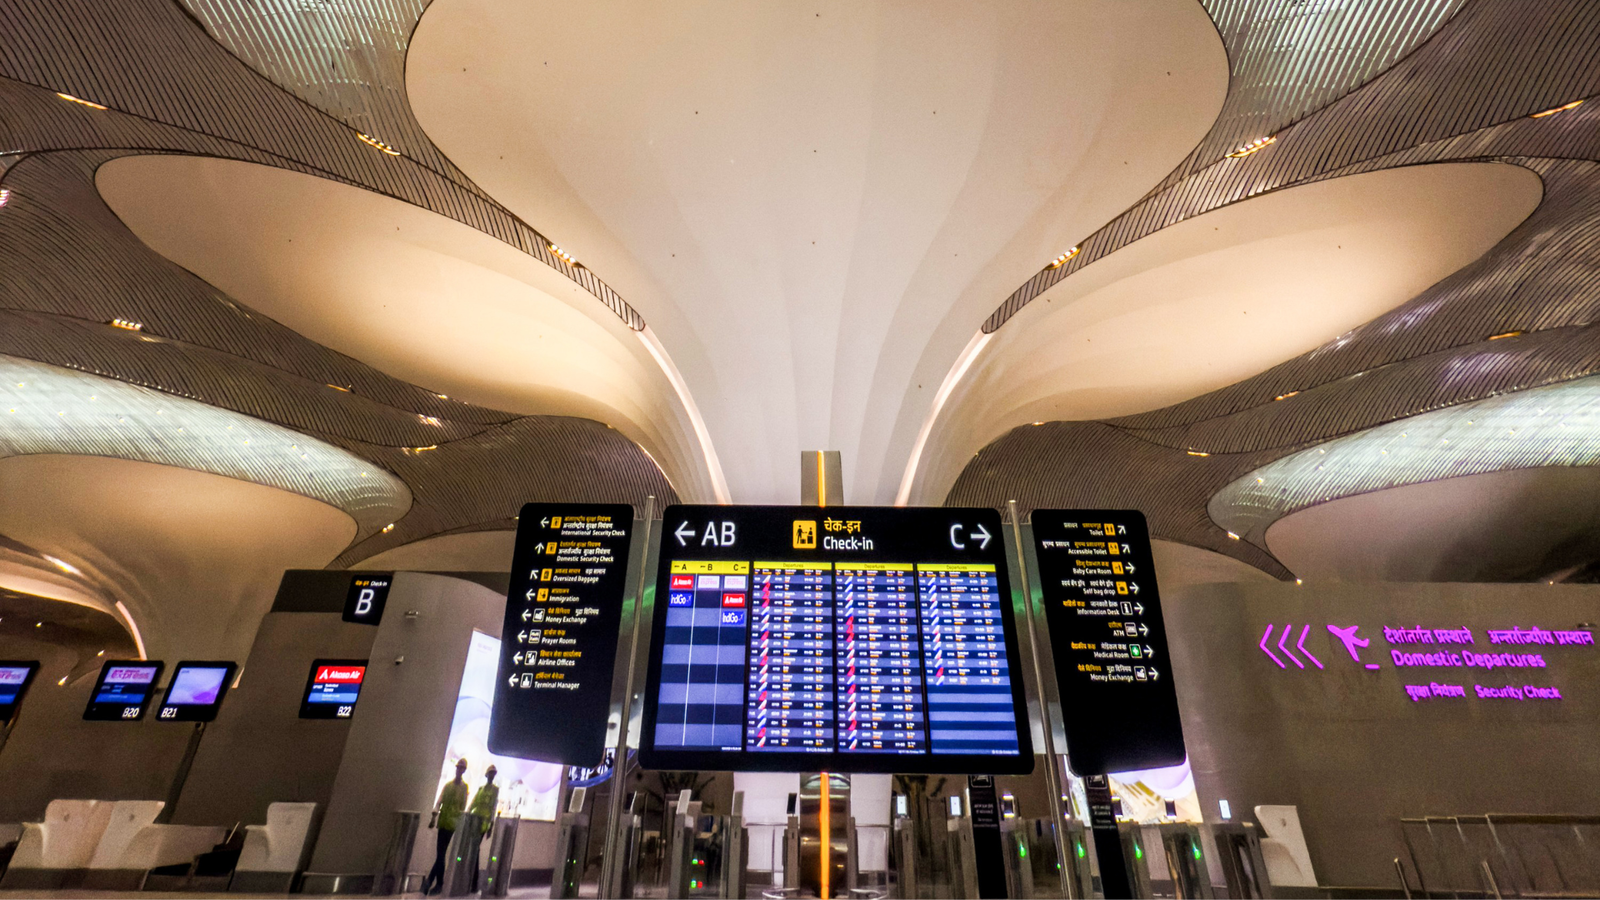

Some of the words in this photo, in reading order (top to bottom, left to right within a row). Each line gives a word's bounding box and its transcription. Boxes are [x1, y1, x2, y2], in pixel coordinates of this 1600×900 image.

[824, 516, 862, 534] चेक-इन
[592, 529, 611, 538] Security
[701, 521, 736, 547] AB
[950, 524, 965, 549] C
[823, 536, 874, 550] Check-in
[1093, 588, 1104, 596] bag
[354, 589, 374, 614] B
[562, 616, 587, 624] Exchange
[541, 637, 558, 645] Prayer
[1390, 650, 1462, 667] Domestic
[1462, 650, 1546, 670] Departures
[1090, 674, 1108, 682] Money
[1108, 674, 1134, 682] Exchange
[557, 682, 580, 690] Manager
[1474, 684, 1523, 700] Security
[1523, 685, 1562, 700] Check
[122, 707, 140, 718] B20
[161, 708, 178, 718] B21
[337, 706, 352, 717] B22
